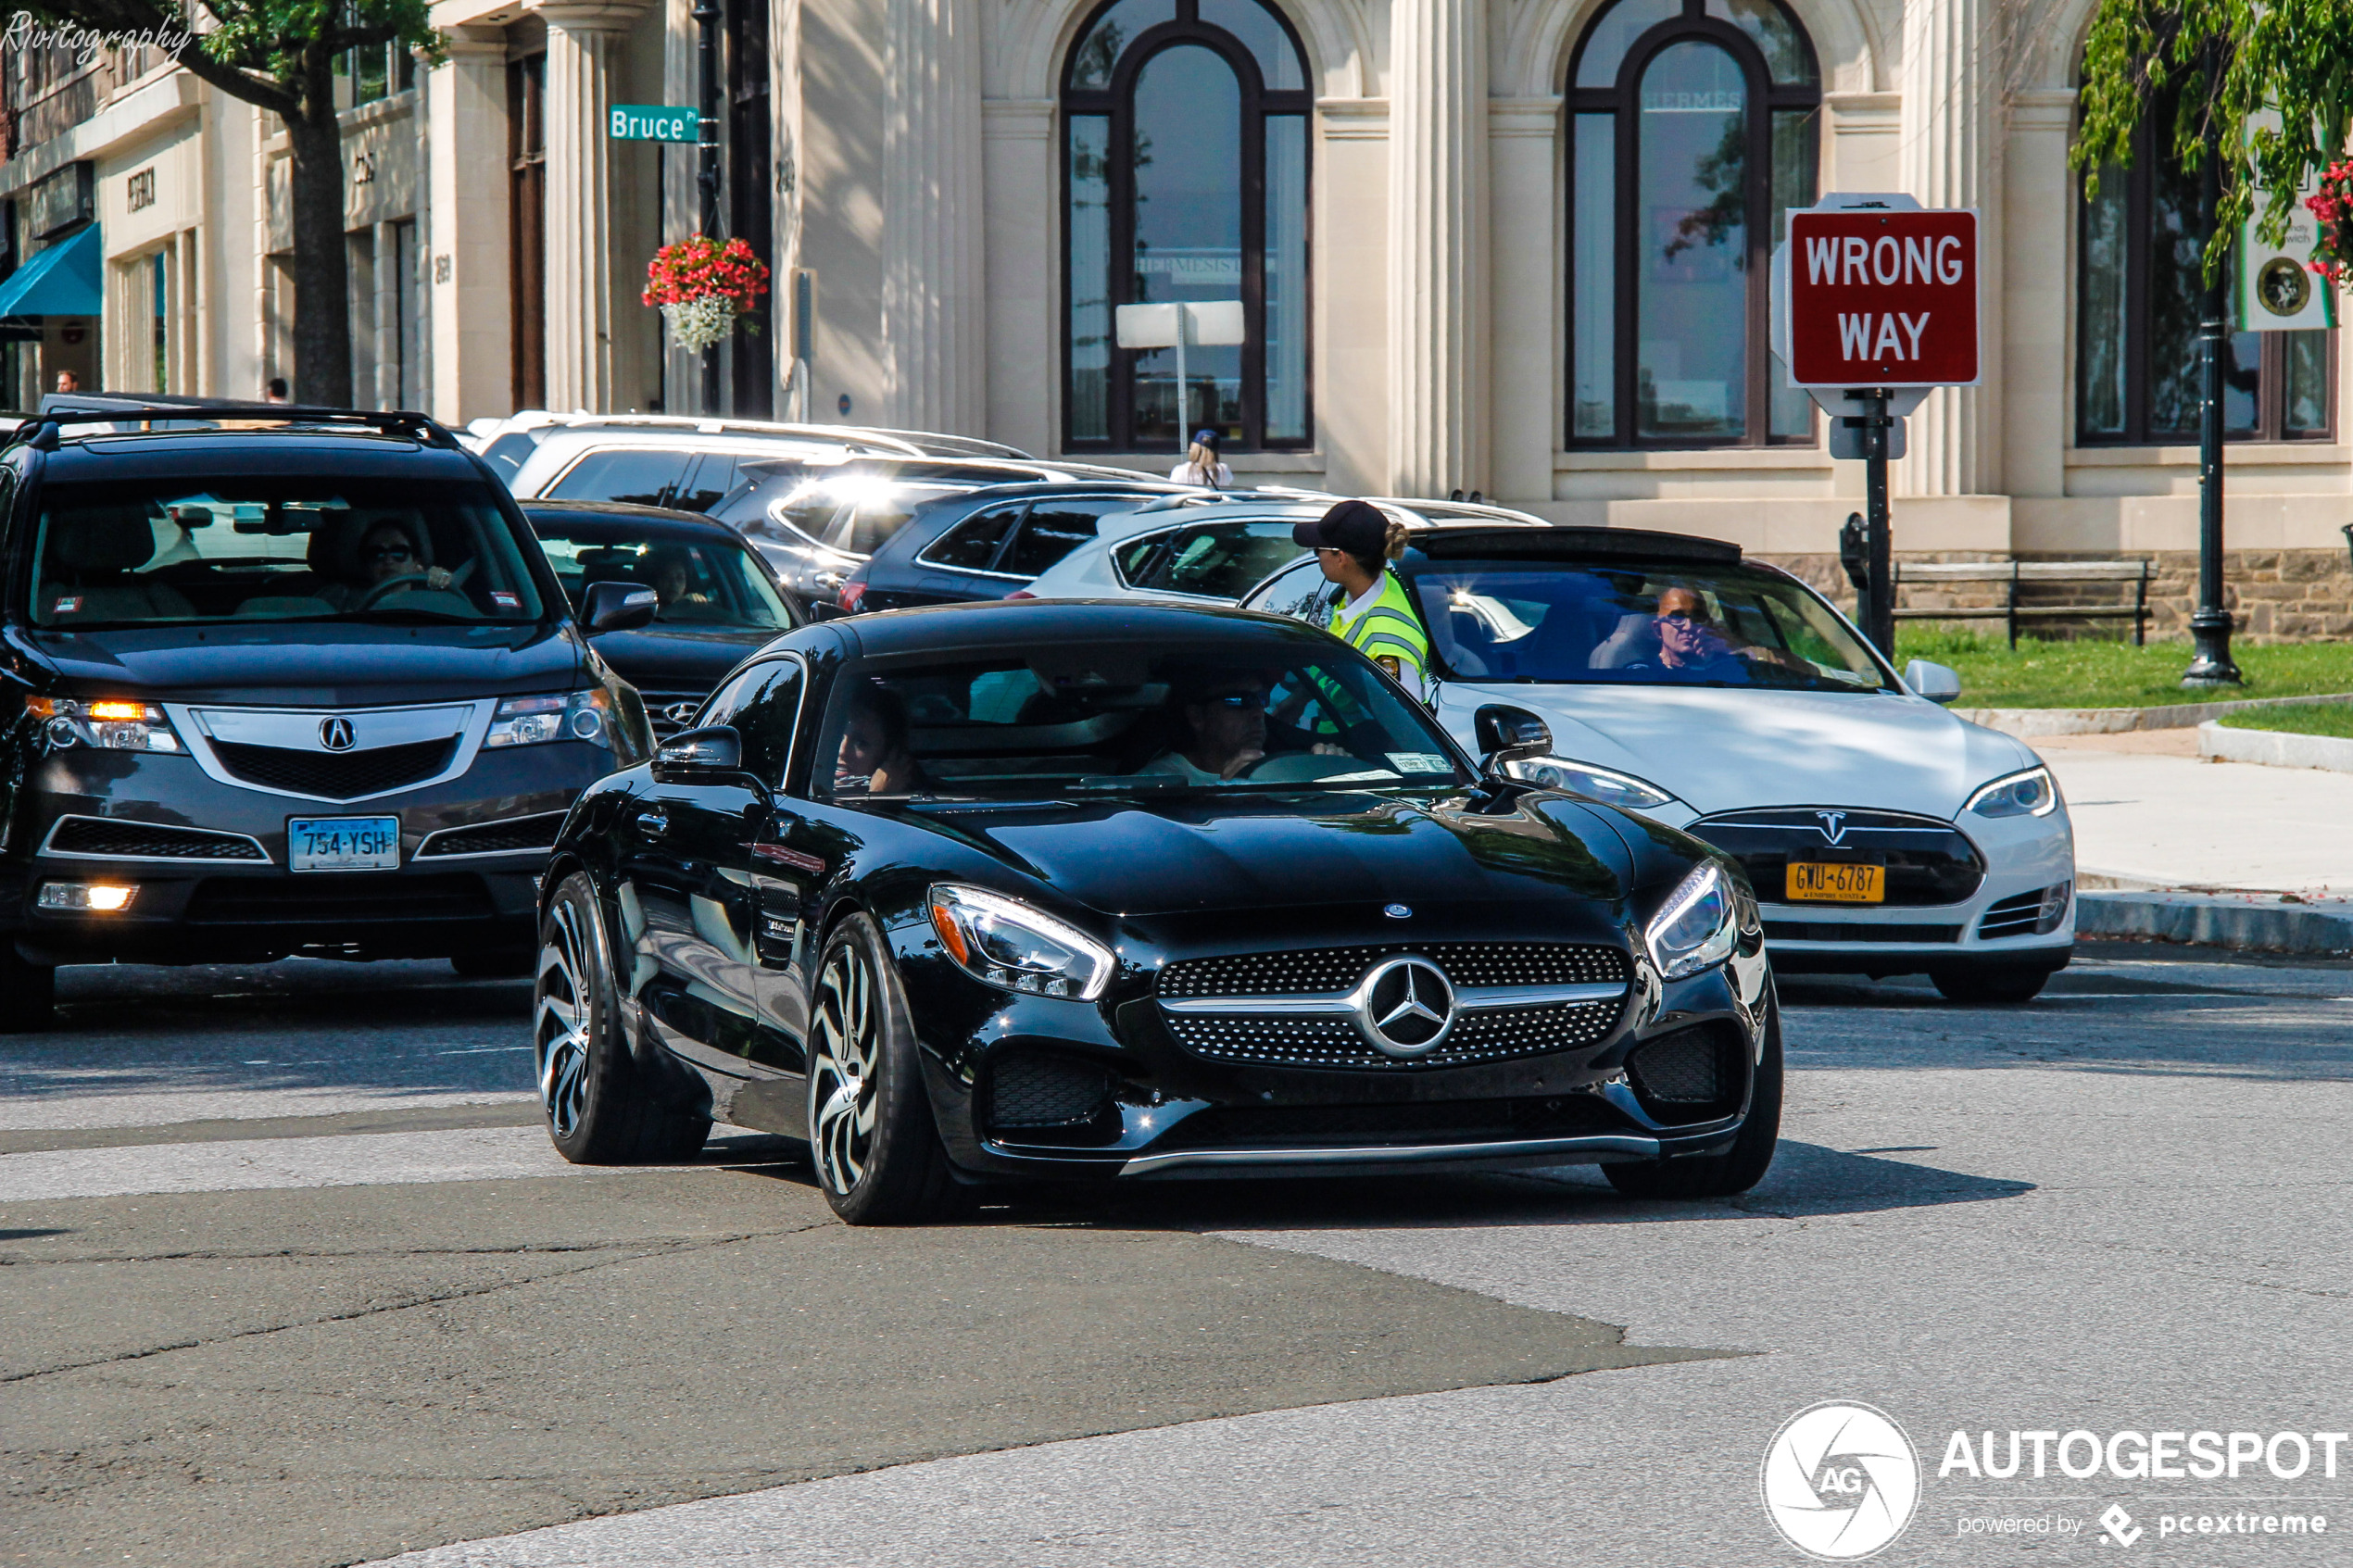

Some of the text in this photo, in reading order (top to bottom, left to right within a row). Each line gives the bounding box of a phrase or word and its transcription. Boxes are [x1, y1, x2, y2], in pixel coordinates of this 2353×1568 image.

[611, 110, 685, 140] Bruce
[1806, 235, 1963, 286] WRONG
[1837, 311, 1931, 361] WAY
